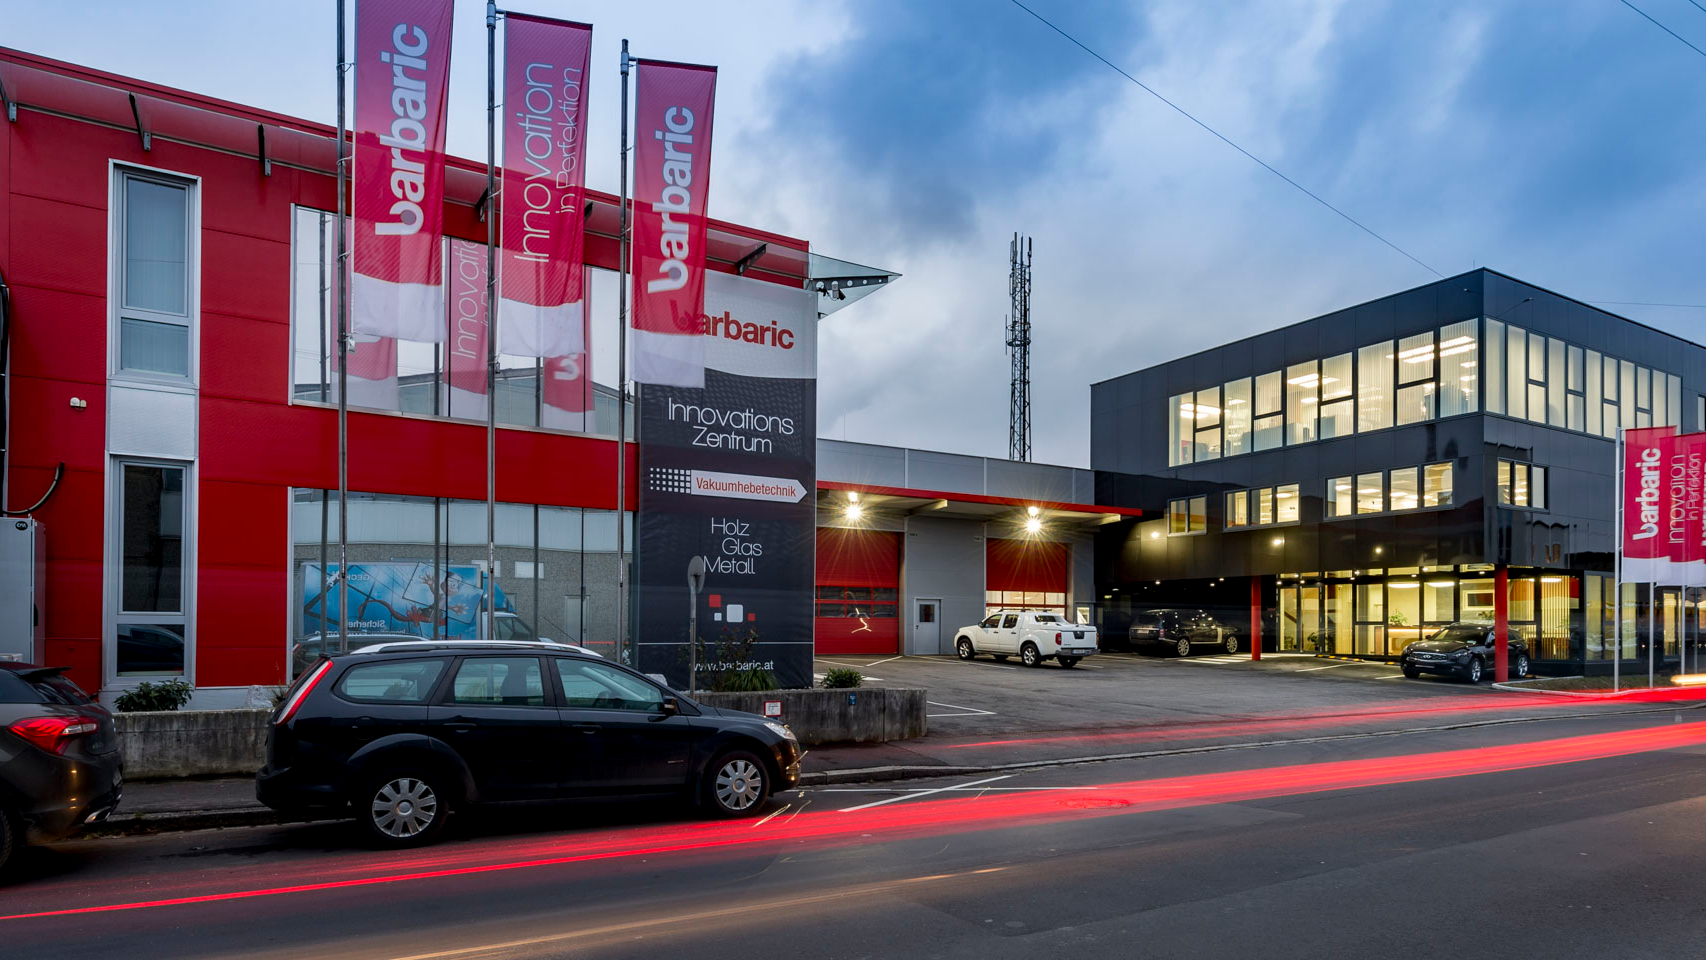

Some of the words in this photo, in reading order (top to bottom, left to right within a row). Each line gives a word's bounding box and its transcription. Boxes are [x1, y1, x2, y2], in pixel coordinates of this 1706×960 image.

[374, 22, 429, 236] barbaric
[556, 67, 581, 189] Perfektion
[513, 62, 554, 263] Innovation
[555, 193, 576, 213] in
[647, 105, 695, 294] barbaric
[451, 240, 479, 359] Innovati
[668, 397, 794, 435] Innovations
[692, 425, 772, 454] Zentrum
[696, 477, 797, 497] Vakuumhebetechnik
[1632, 447, 1662, 540] barbaric
[1668, 454, 1686, 544] Innovation
[711, 516, 750, 537] Holz
[721, 537, 763, 557] Glas
[703, 555, 756, 575] Metall
